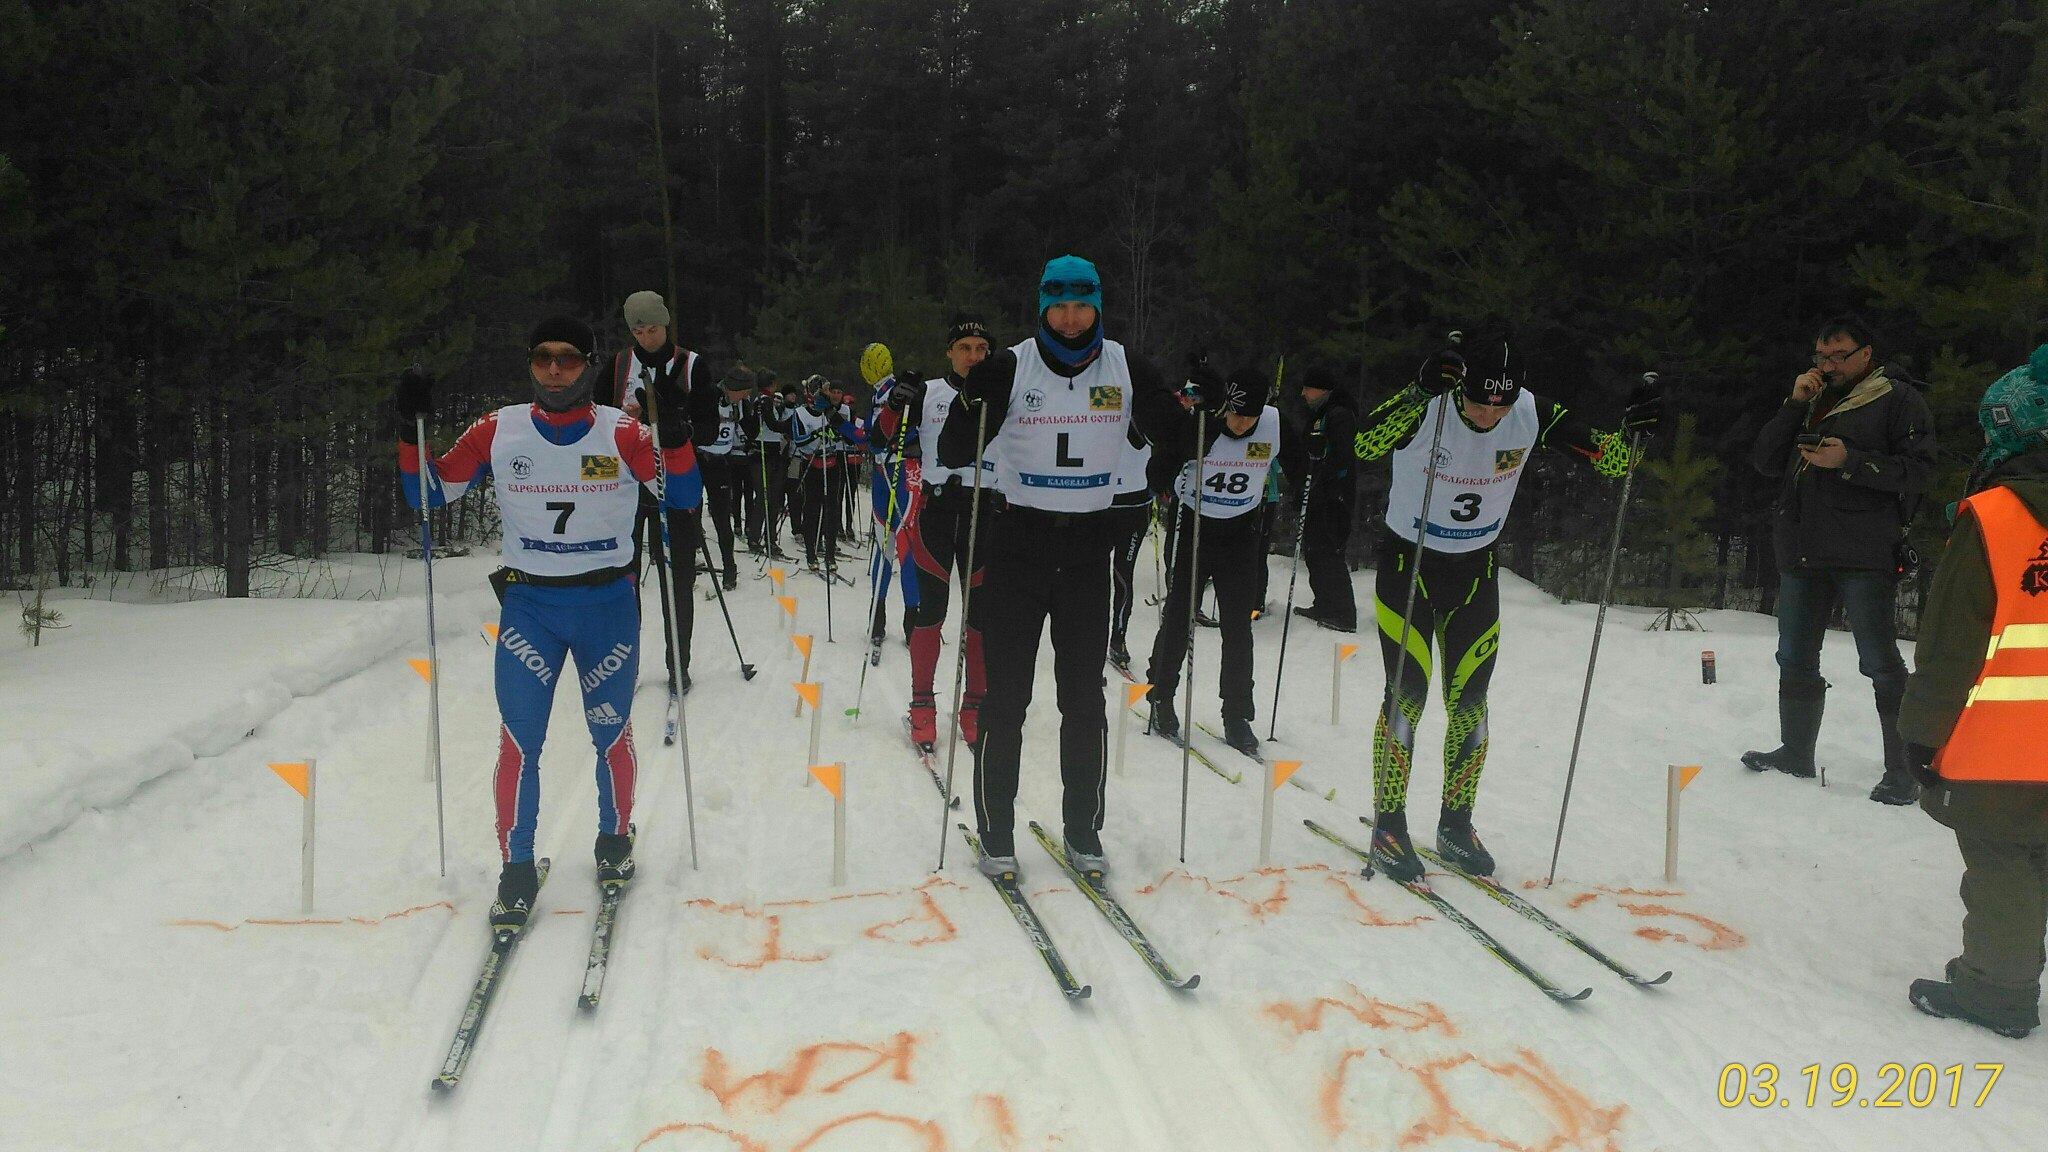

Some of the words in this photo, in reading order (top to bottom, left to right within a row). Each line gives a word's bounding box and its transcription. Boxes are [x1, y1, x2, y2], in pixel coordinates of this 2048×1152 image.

[1484, 372, 1513, 395] DNB
[1019, 415, 1088, 425] КАРЕЛЬСКАЯ
[1090, 415, 1122, 424] СОТНЯ
[1056, 432, 1084, 467] L
[508, 483, 578, 493] КАРЕЛЬСКАЯ
[582, 482, 620, 493] СОТНЯ
[1205, 472, 1250, 495] 48
[1423, 466, 1490, 486] КРЕЛЬСКАЯ
[545, 501, 576, 535] 7
[1450, 492, 1482, 522] 3
[1127, 537, 1138, 562] CRAFT
[500, 626, 553, 687] LUKOIL
[581, 642, 632, 693] LUKOIL
